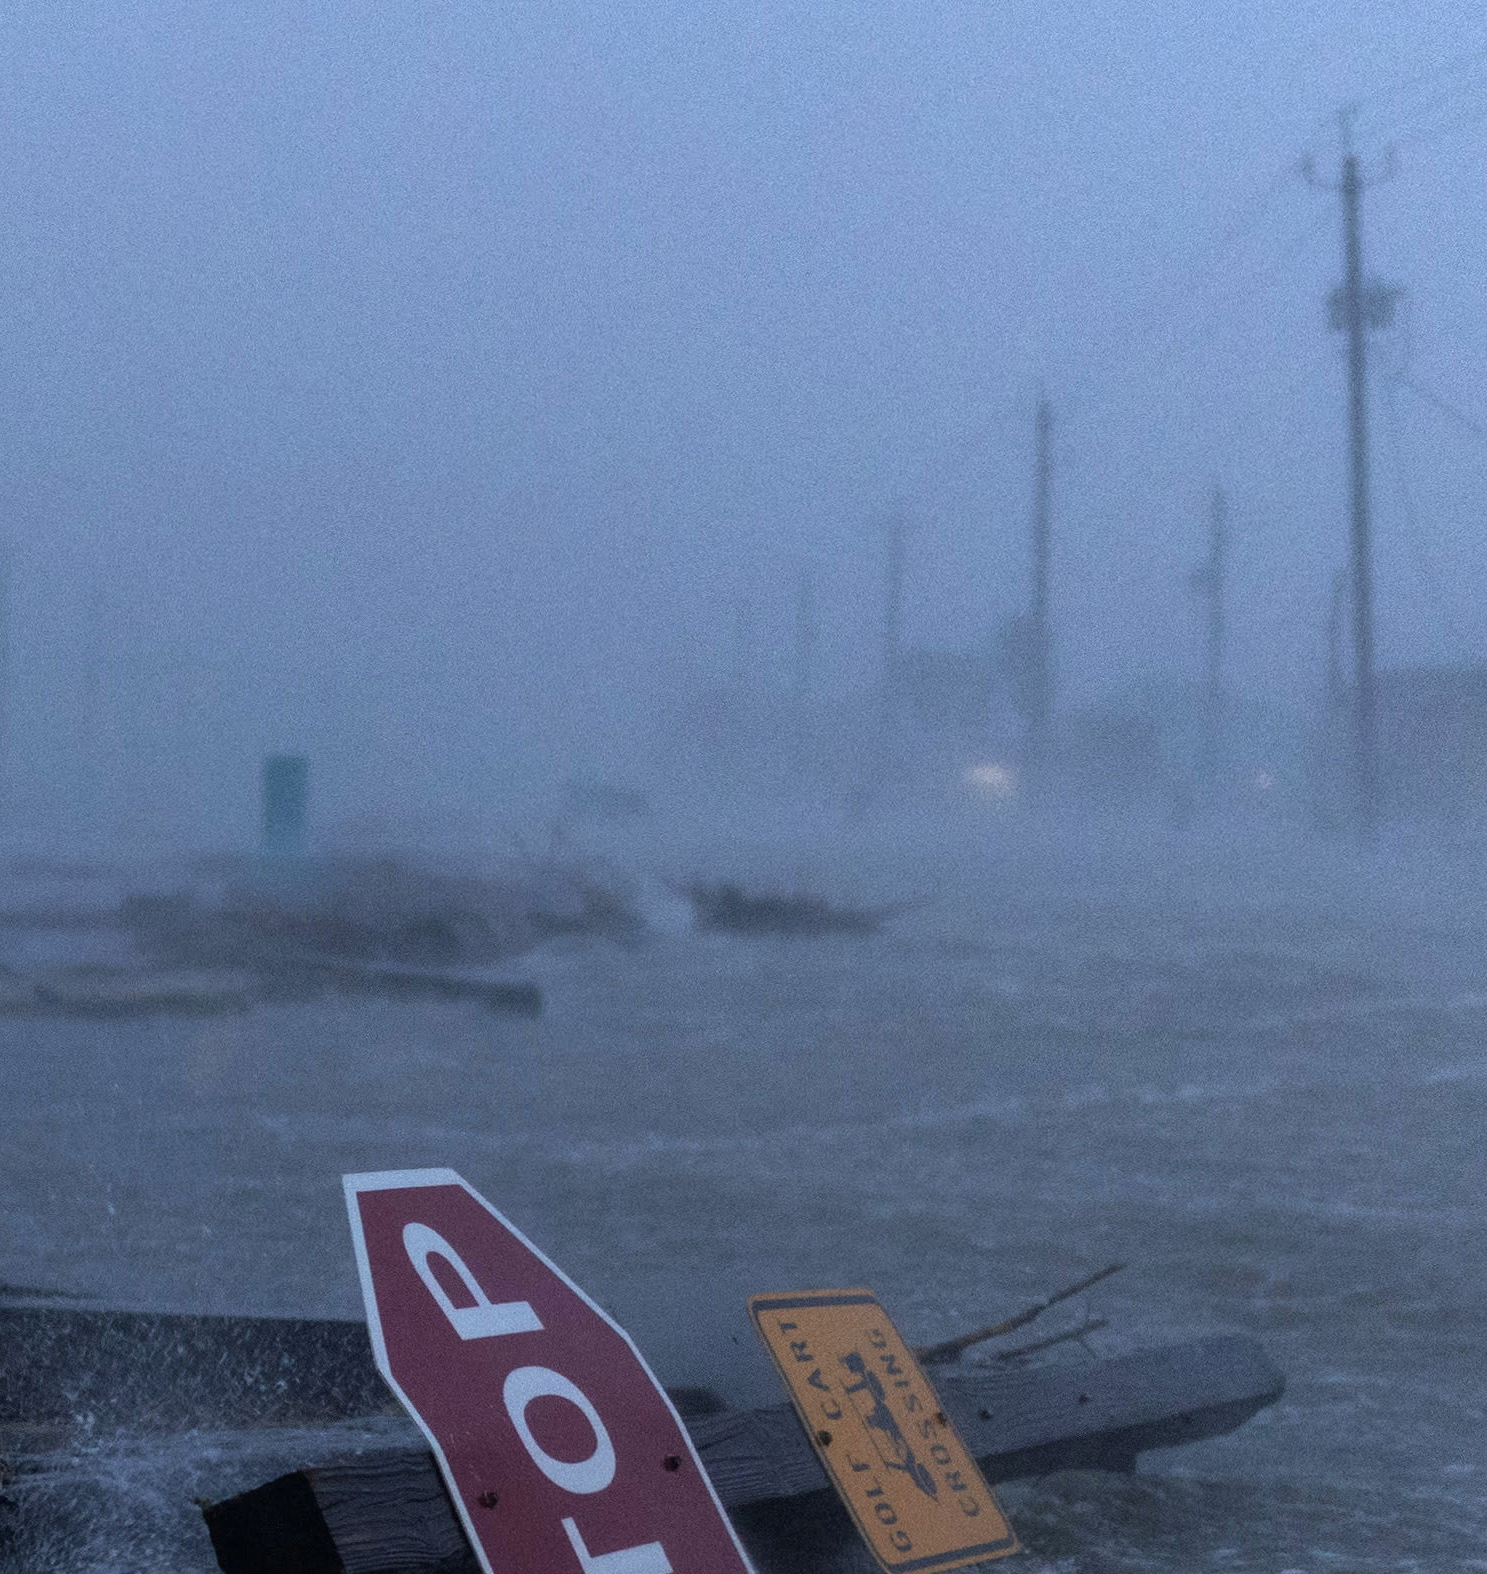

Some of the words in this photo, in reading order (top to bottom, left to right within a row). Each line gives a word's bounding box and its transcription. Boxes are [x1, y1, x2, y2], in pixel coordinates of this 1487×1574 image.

[778, 1319, 842, 1420] CART
[866, 1328, 979, 1518] CROSSING
[847, 1454, 913, 1552] GOLF
